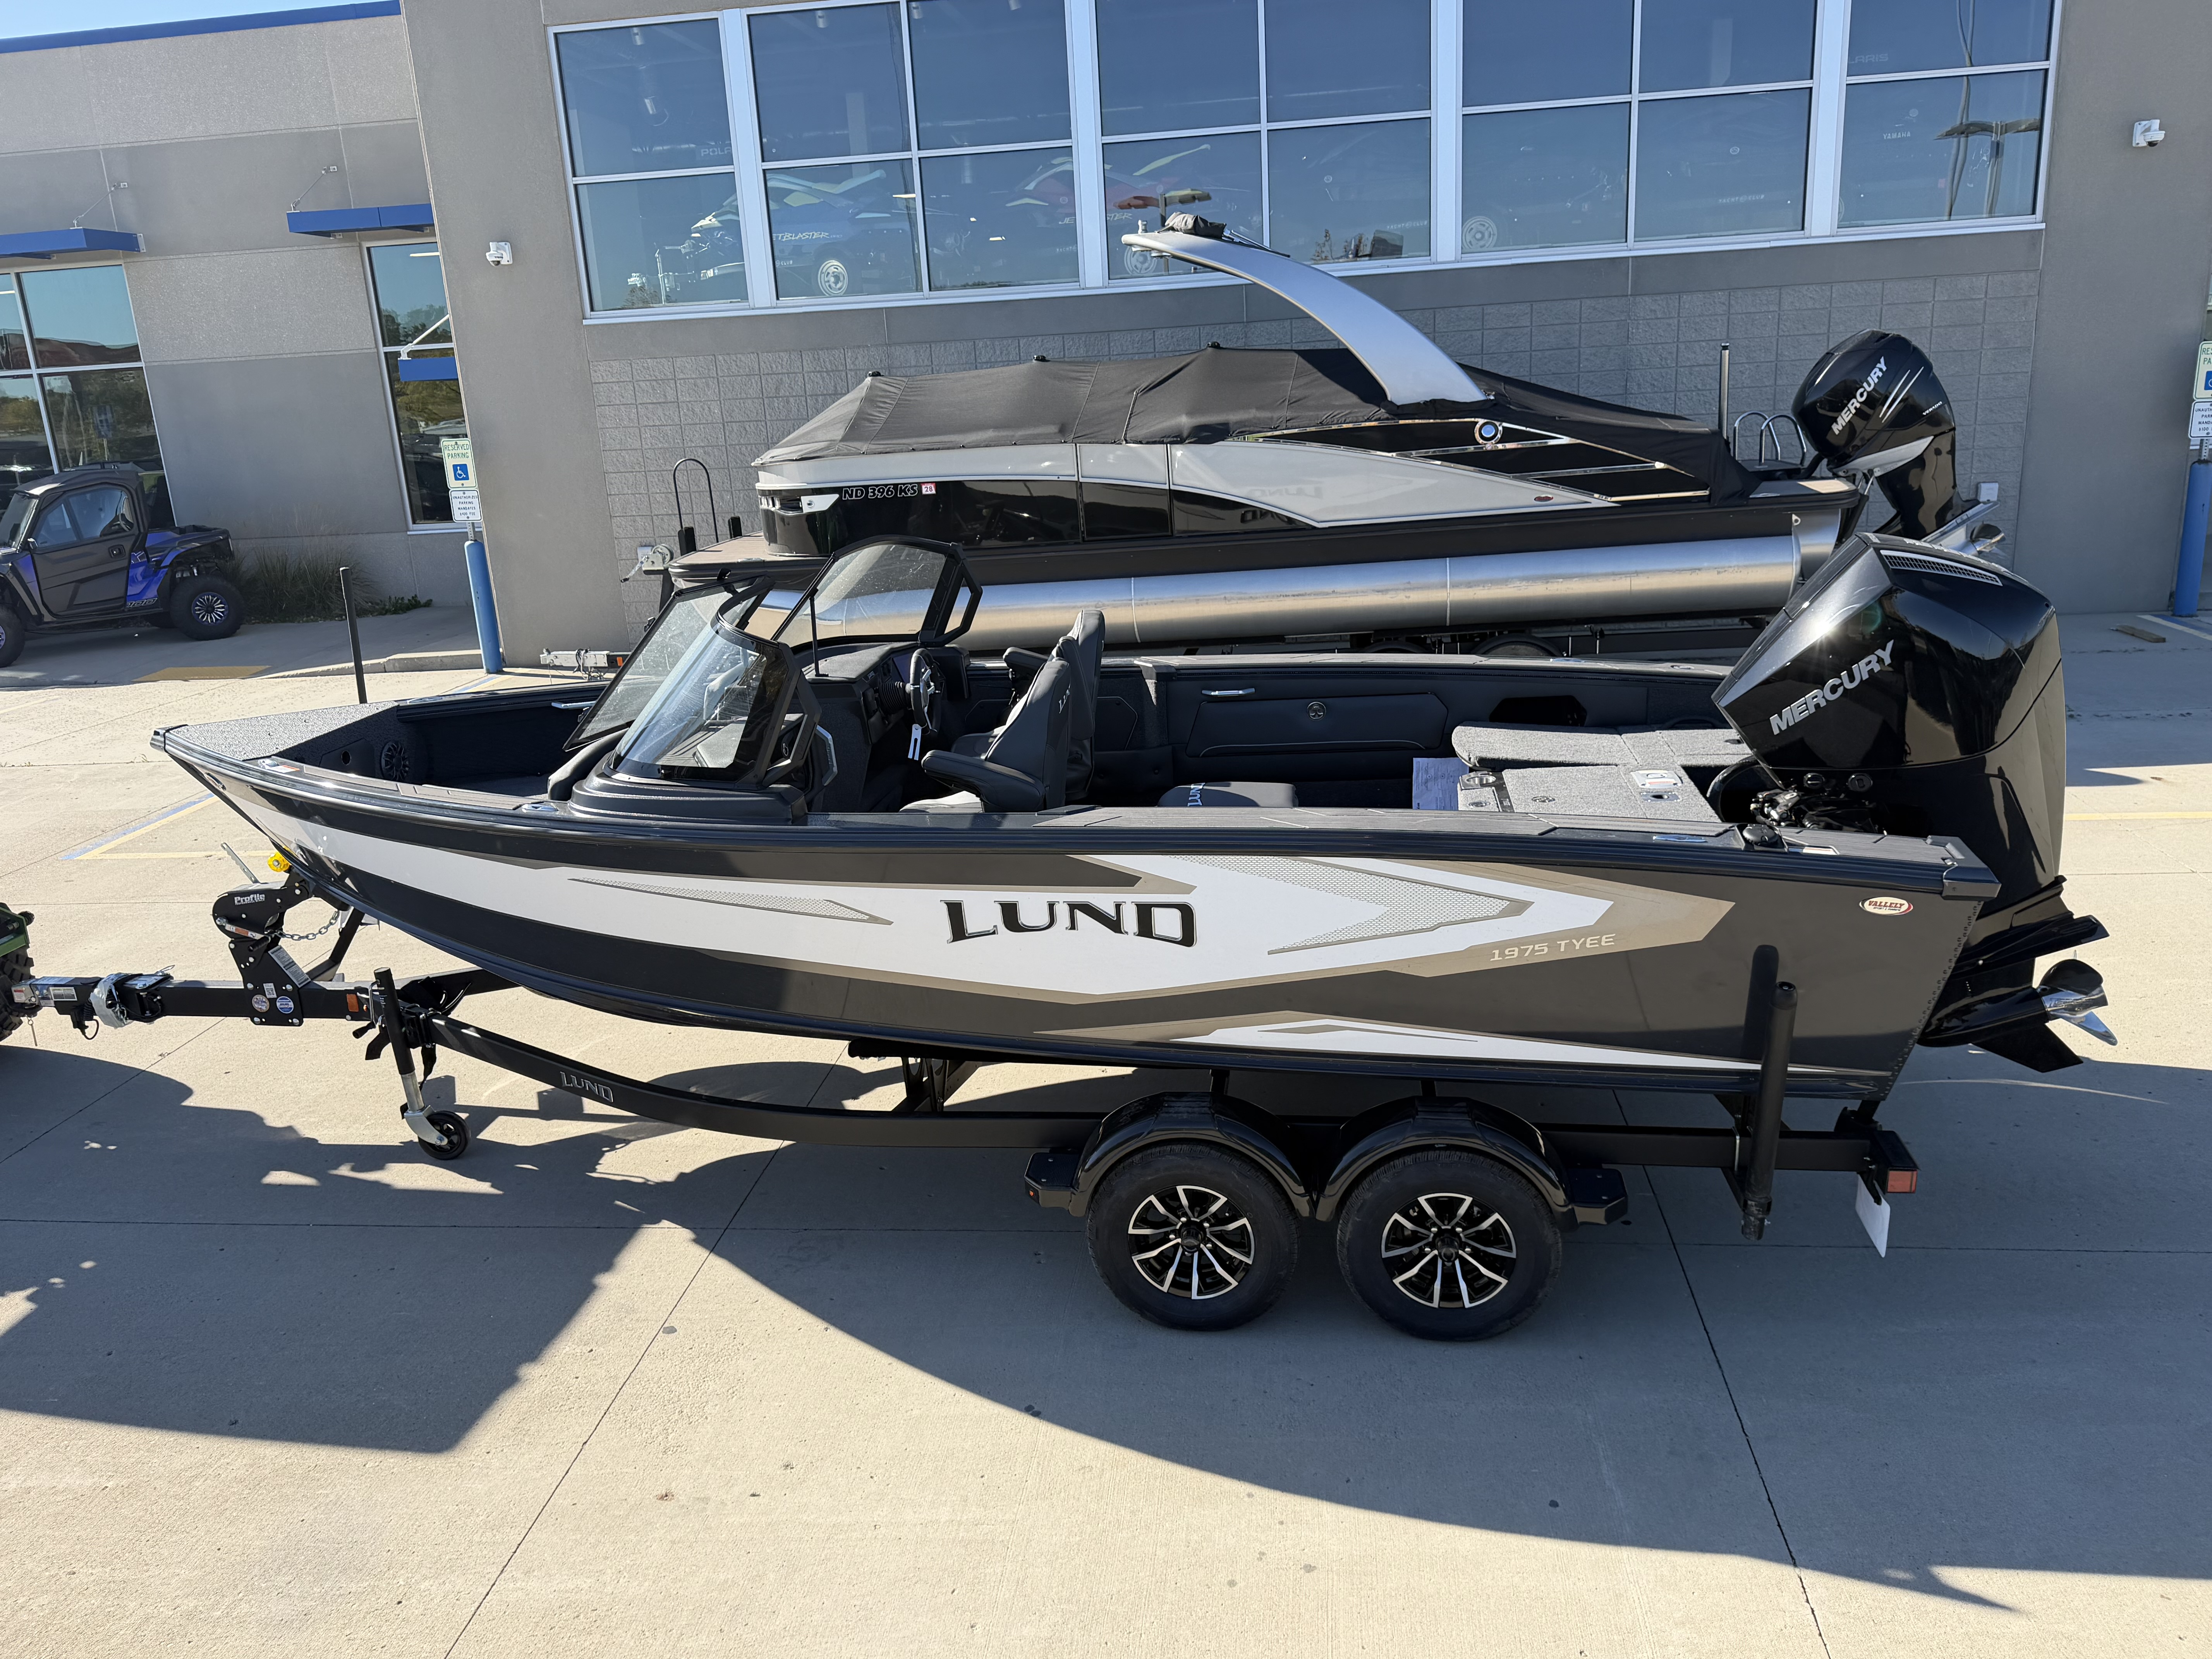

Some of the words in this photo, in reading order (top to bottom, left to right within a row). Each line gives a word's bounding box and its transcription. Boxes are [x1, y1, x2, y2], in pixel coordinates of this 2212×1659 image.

[1848, 53, 1889, 64] LARIS
[1883, 131, 1911, 139] YAMAHA
[701, 147, 732, 156] POLA
[773, 232, 830, 241] ETBLASTER
[1831, 356, 1887, 435] MERCURY
[842, 487, 865, 500] ND
[868, 485, 895, 499] 396
[898, 484, 918, 497] KS
[1770, 639, 1894, 735] MERCURY
[234, 893, 265, 903] Profile
[1869, 900, 1905, 908] VALLELY
[939, 900, 1197, 948] LUND
[1490, 943, 1549, 961] 1975
[1557, 934, 1616, 952] TYEE
[560, 1071, 613, 1103] LUND
